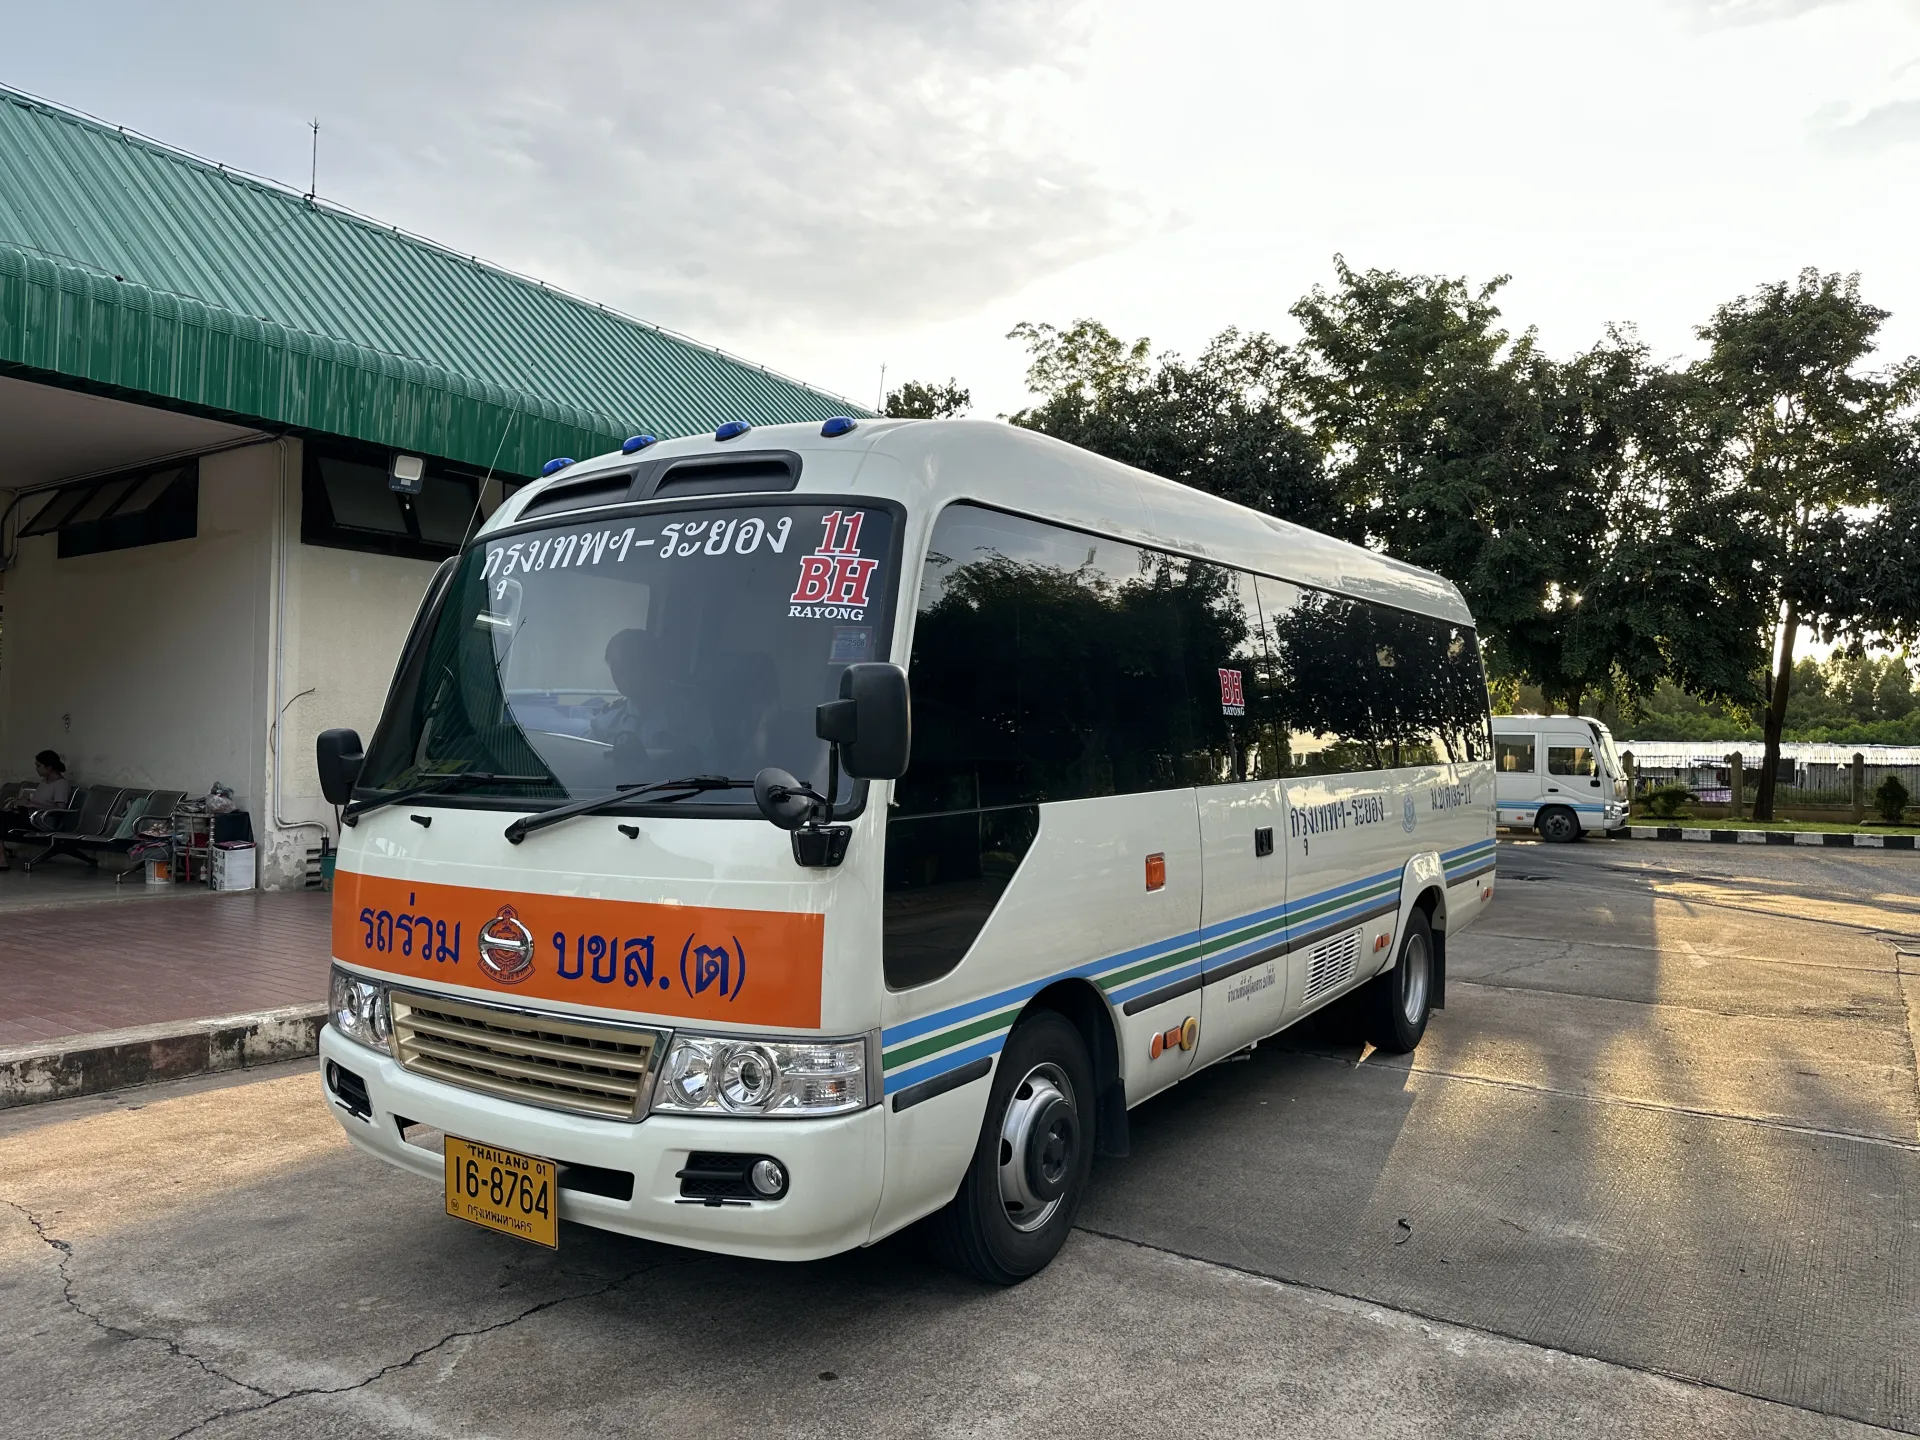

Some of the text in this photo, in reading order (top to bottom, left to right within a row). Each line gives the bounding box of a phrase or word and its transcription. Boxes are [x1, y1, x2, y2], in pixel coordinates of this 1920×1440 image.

[814, 510, 864, 556] 11
[479, 516, 793, 599] กรุงเทพฯ-ระยอง
[789, 555, 879, 607] BH
[788, 605, 864, 621] RAYONG
[1218, 668, 1245, 706] BH
[1222, 706, 1245, 717] RAYONG
[1290, 796, 1385, 856] กรุงเทพฯ-ระยอง
[360, 892, 461, 964] รถร่วม
[470, 1145, 546, 1176] THAILAND 01
[456, 1156, 548, 1220] 16-8764
[467, 1204, 532, 1233] กรุงเทพมหานคร
